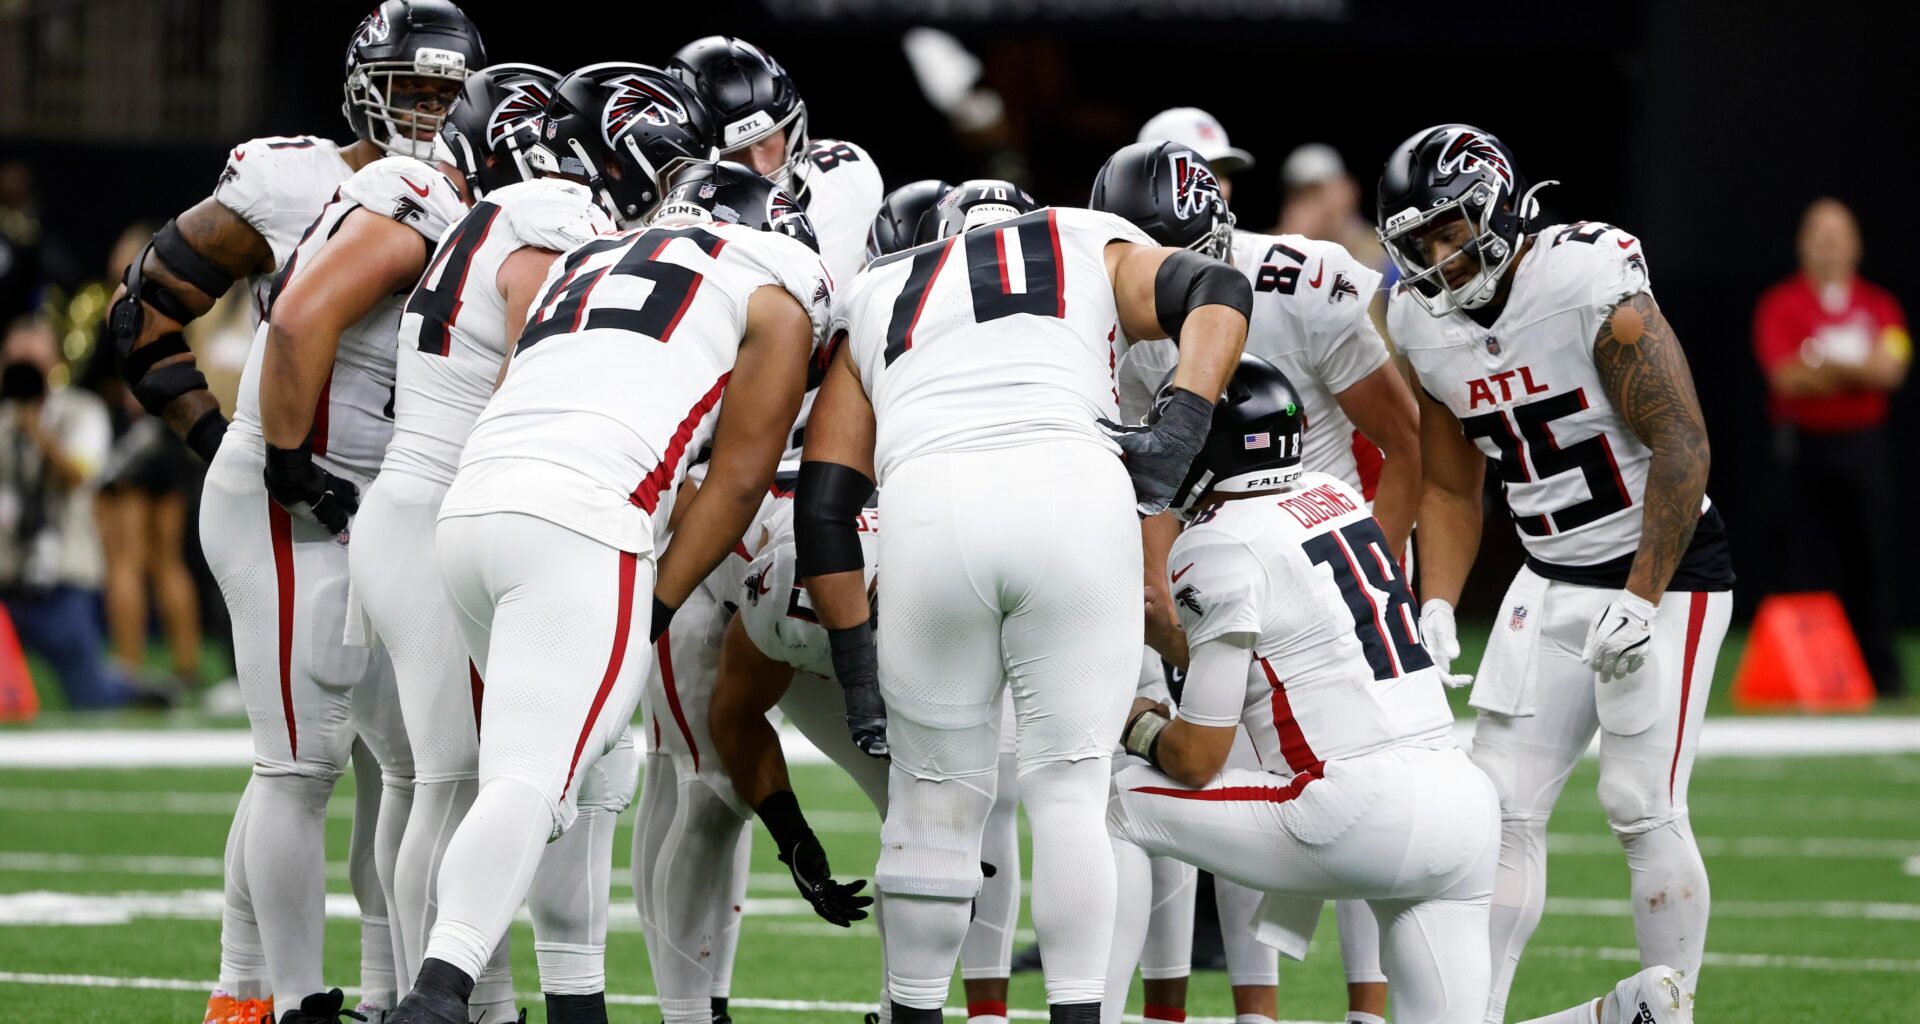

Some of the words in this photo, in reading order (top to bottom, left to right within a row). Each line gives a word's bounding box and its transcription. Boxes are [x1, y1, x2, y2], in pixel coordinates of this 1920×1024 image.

[737, 119, 761, 134] ATL
[978, 187, 1007, 200] 70
[513, 228, 728, 357] 65
[868, 209, 1066, 370] 70
[1254, 243, 1307, 296] 87
[1466, 366, 1549, 409] ATL
[1278, 433, 1300, 458] 18
[1460, 387, 1632, 536] 25
[1277, 484, 1358, 529] COUSINS
[1302, 516, 1434, 681] 18
